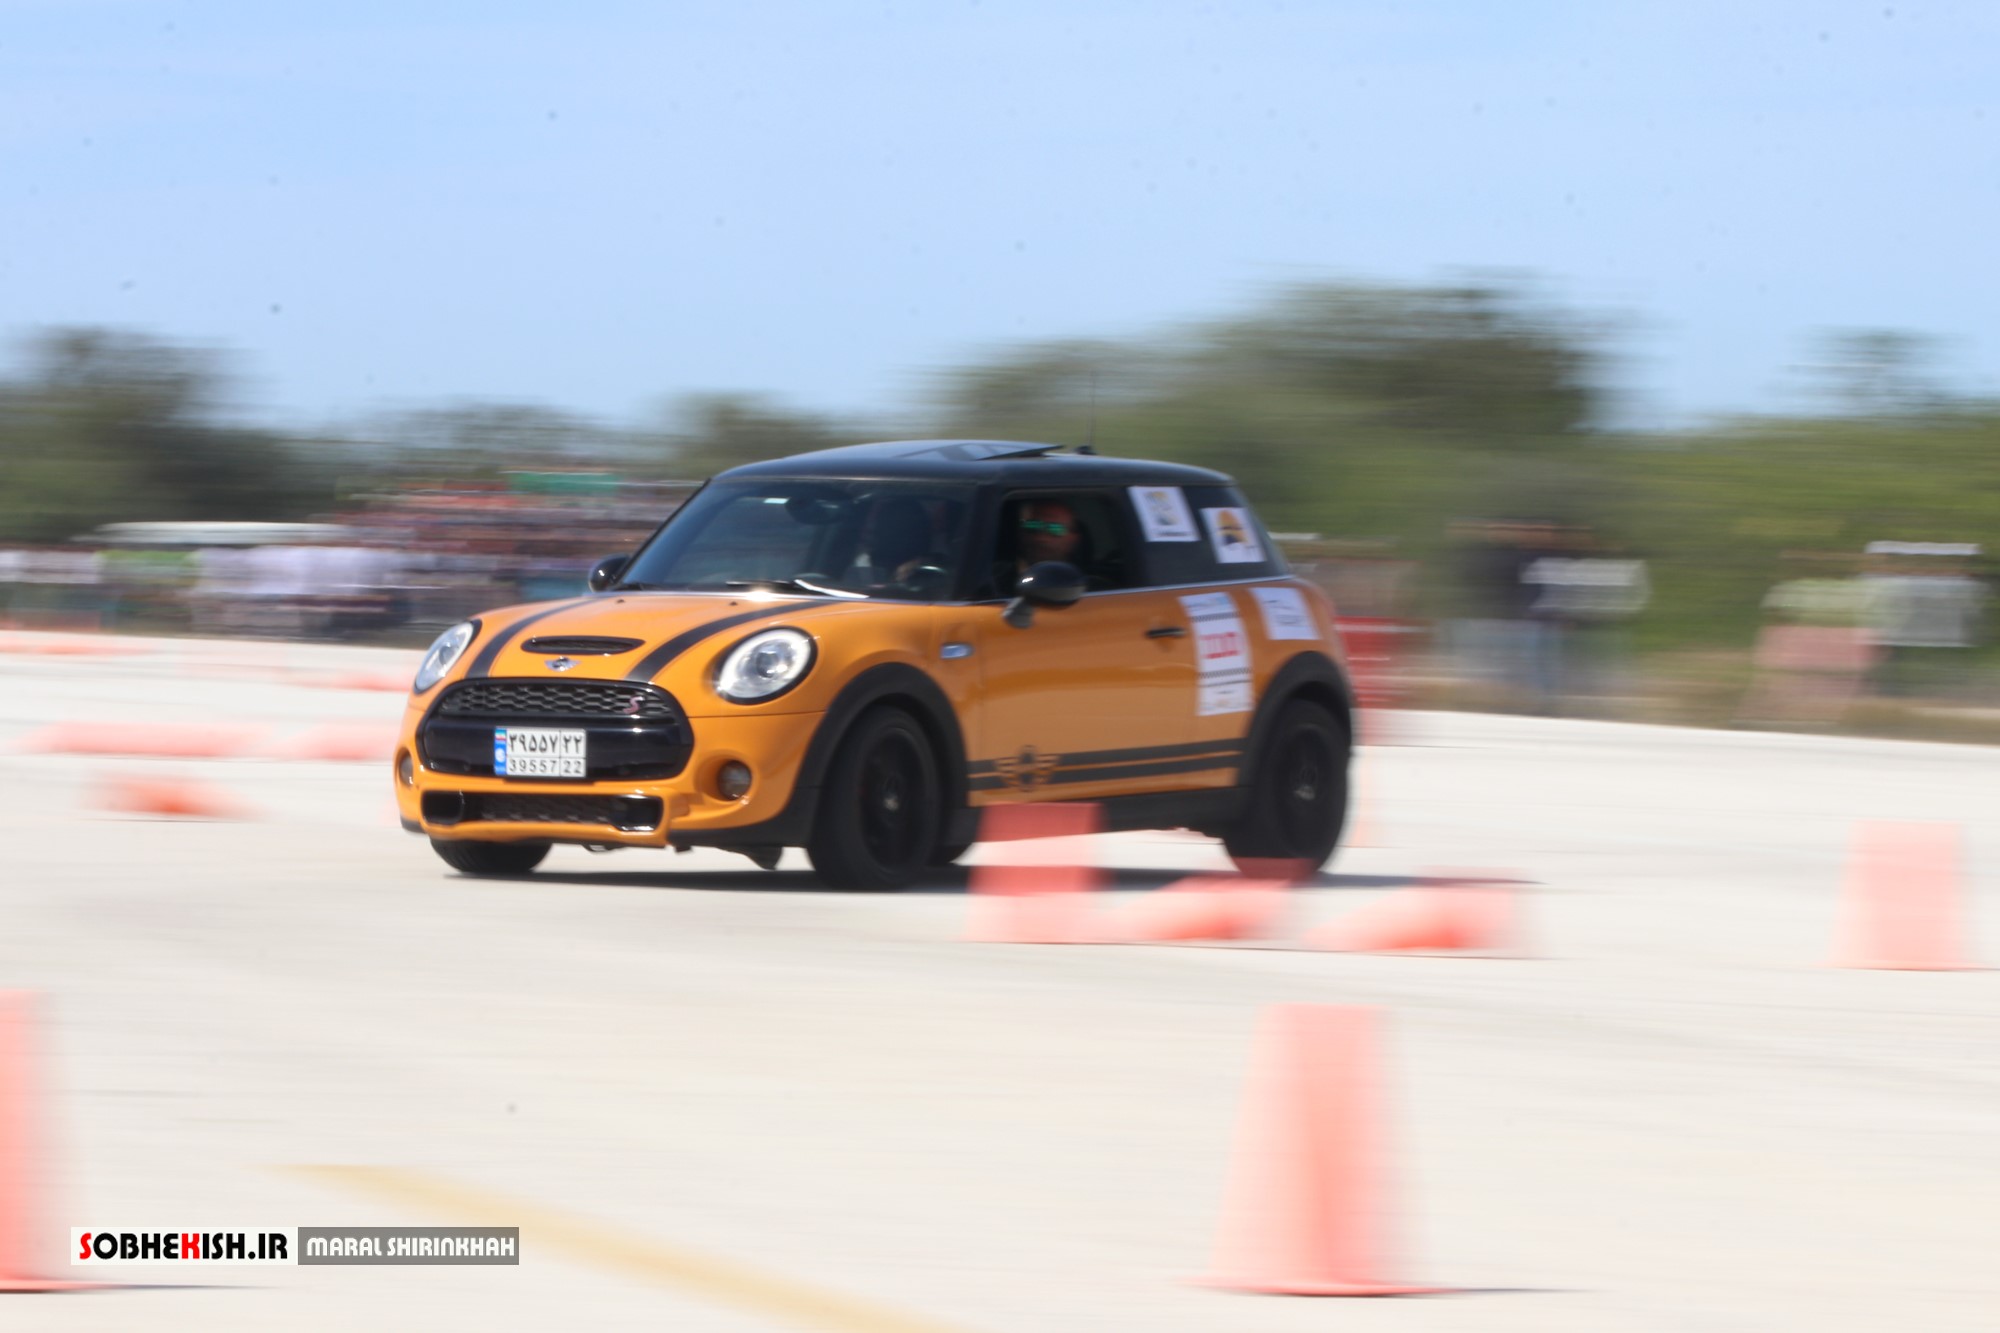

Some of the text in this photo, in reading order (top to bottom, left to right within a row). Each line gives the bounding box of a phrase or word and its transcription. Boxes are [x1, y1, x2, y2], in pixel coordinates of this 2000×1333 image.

[508, 733, 582, 754] ۳۹۵۵۷ ۲۲
[508, 758, 582, 774] 39557 22
